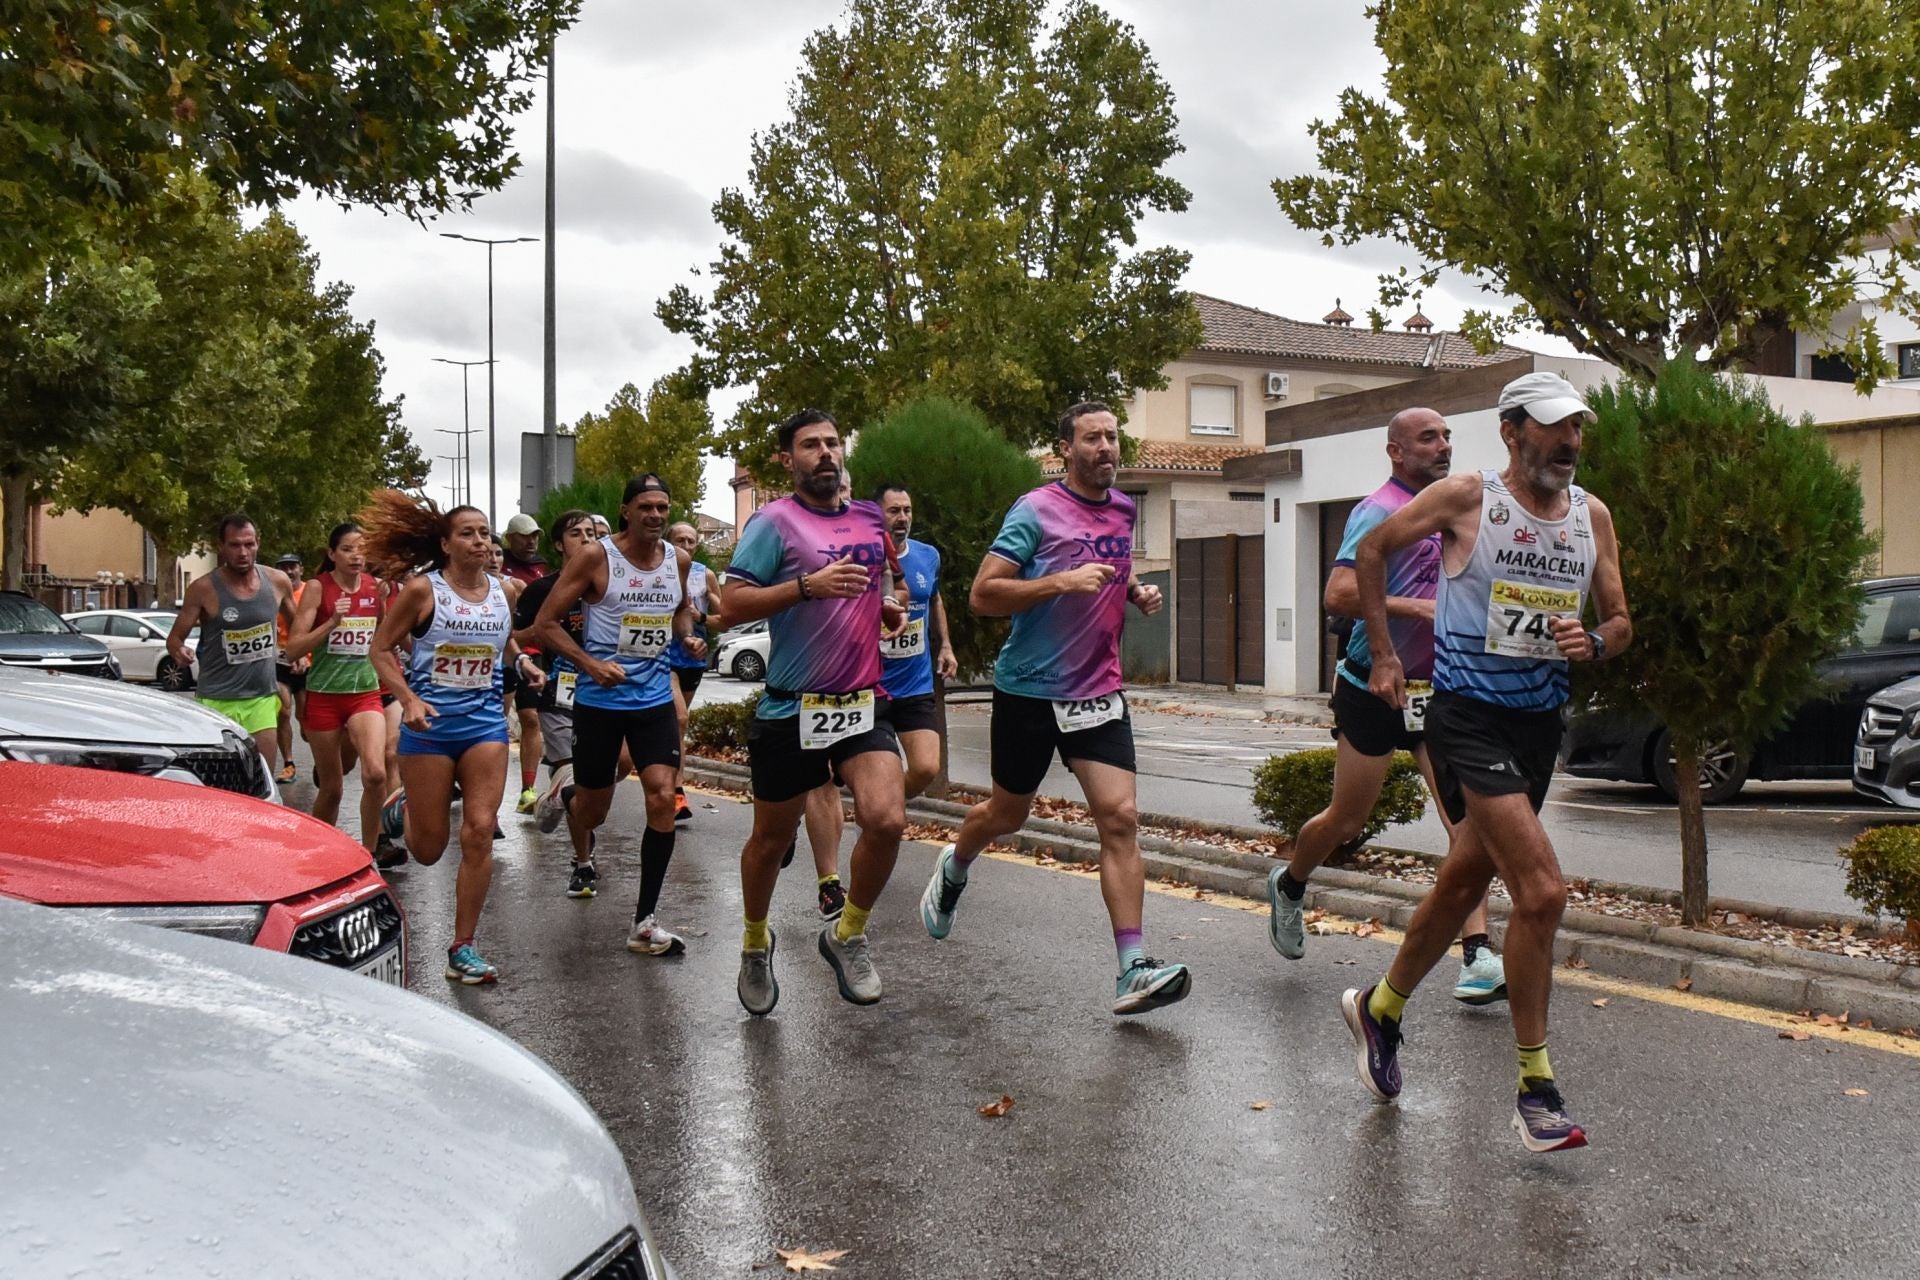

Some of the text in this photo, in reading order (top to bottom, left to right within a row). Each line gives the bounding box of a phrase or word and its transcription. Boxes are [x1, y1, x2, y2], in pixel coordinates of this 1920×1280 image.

[1495, 549, 1585, 578] MARACENA
[620, 592, 674, 604] MARACENA
[1505, 586, 1521, 602] 38
[444, 620, 505, 632] MARACENA
[228, 634, 273, 656] 3262
[629, 629, 667, 646] 753
[434, 656, 493, 677] 2178
[1067, 698, 1112, 717] 245
[1411, 696, 1431, 718] 5
[811, 711, 862, 734] 228
